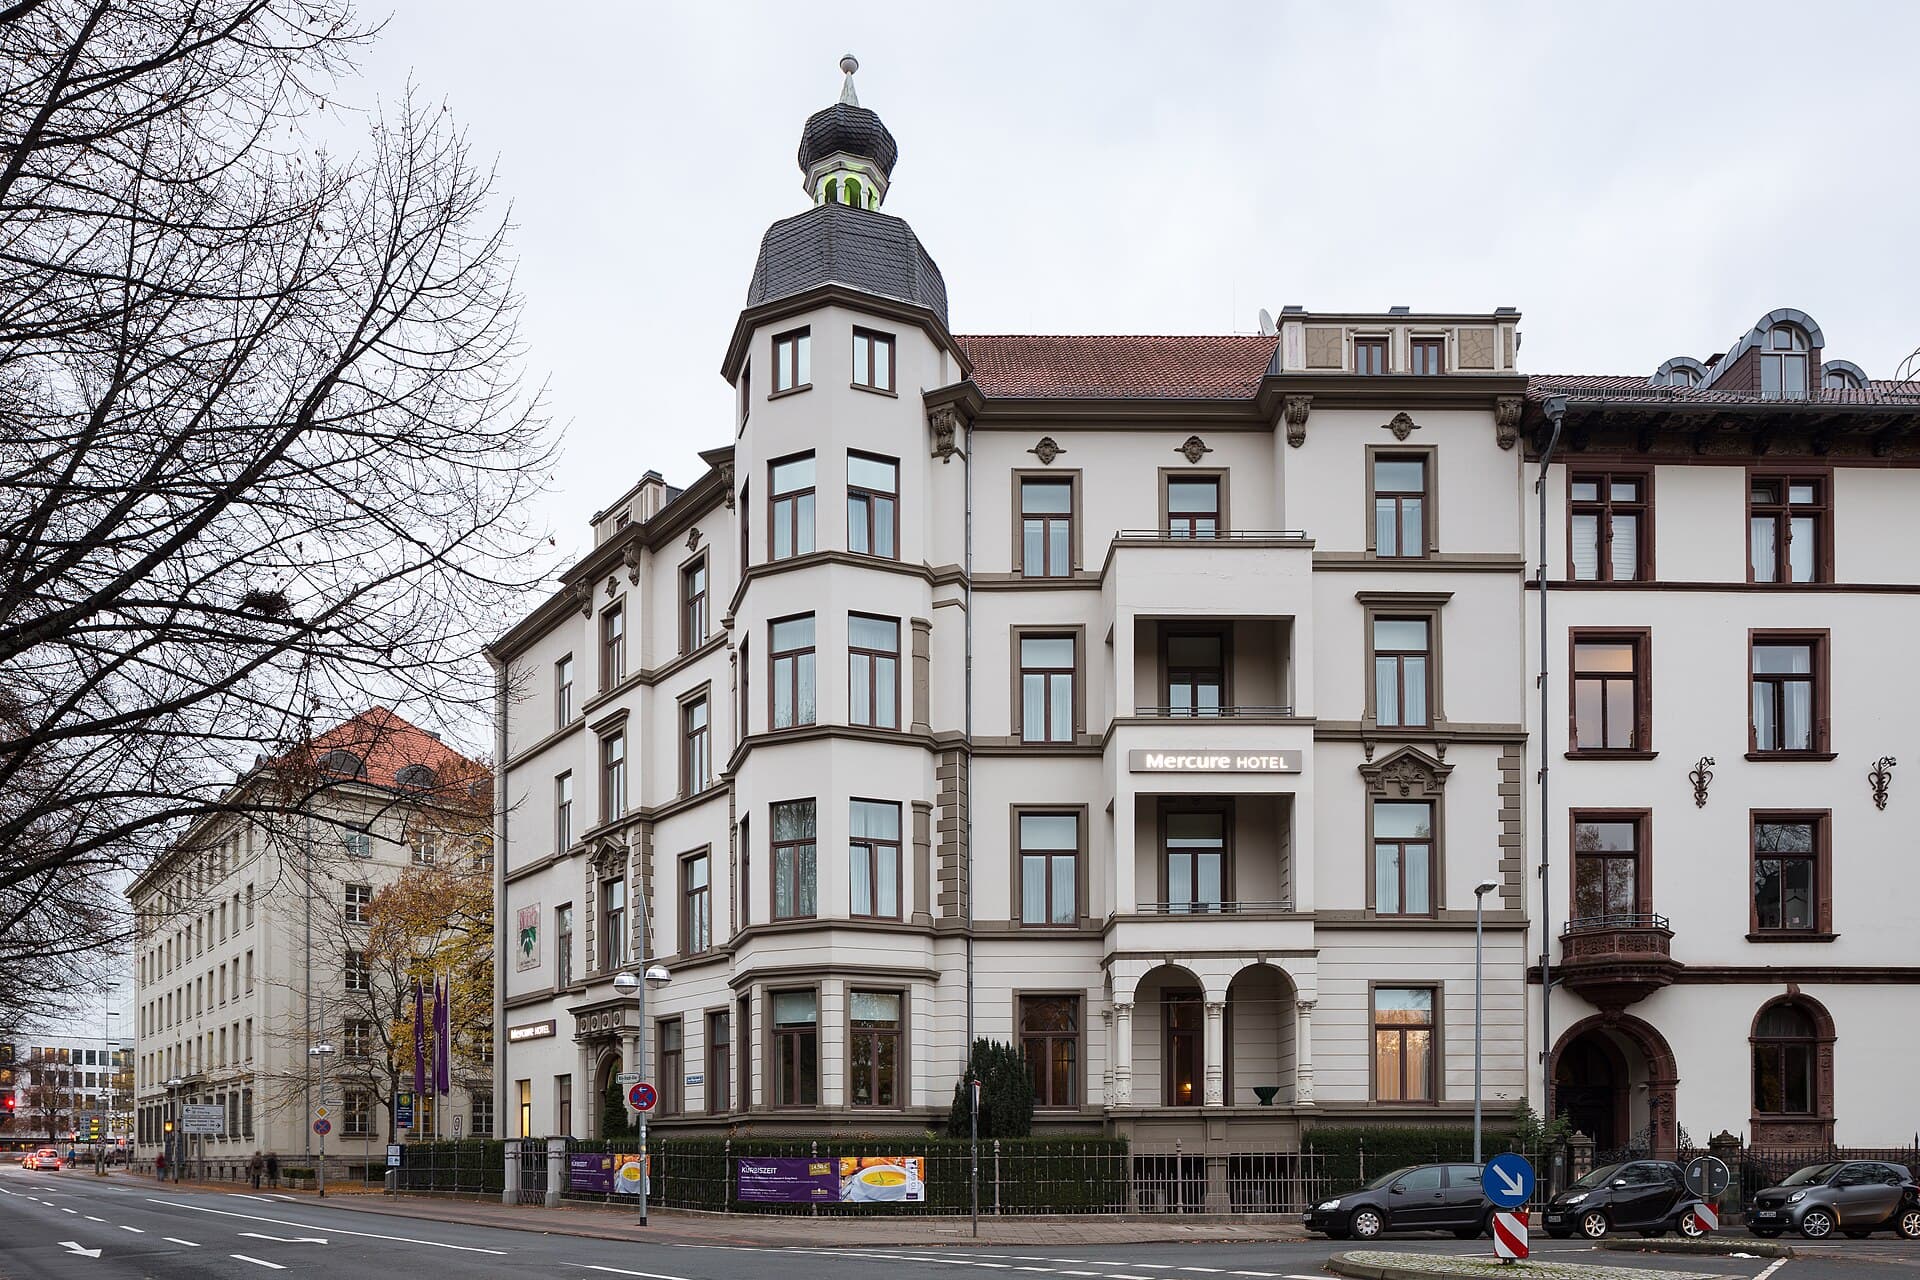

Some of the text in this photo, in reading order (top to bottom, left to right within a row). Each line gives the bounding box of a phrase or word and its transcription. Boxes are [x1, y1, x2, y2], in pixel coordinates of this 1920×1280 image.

[1145, 754, 1288, 769] Mercure HOTEL
[510, 1024, 551, 1040] Mercure HOTEL
